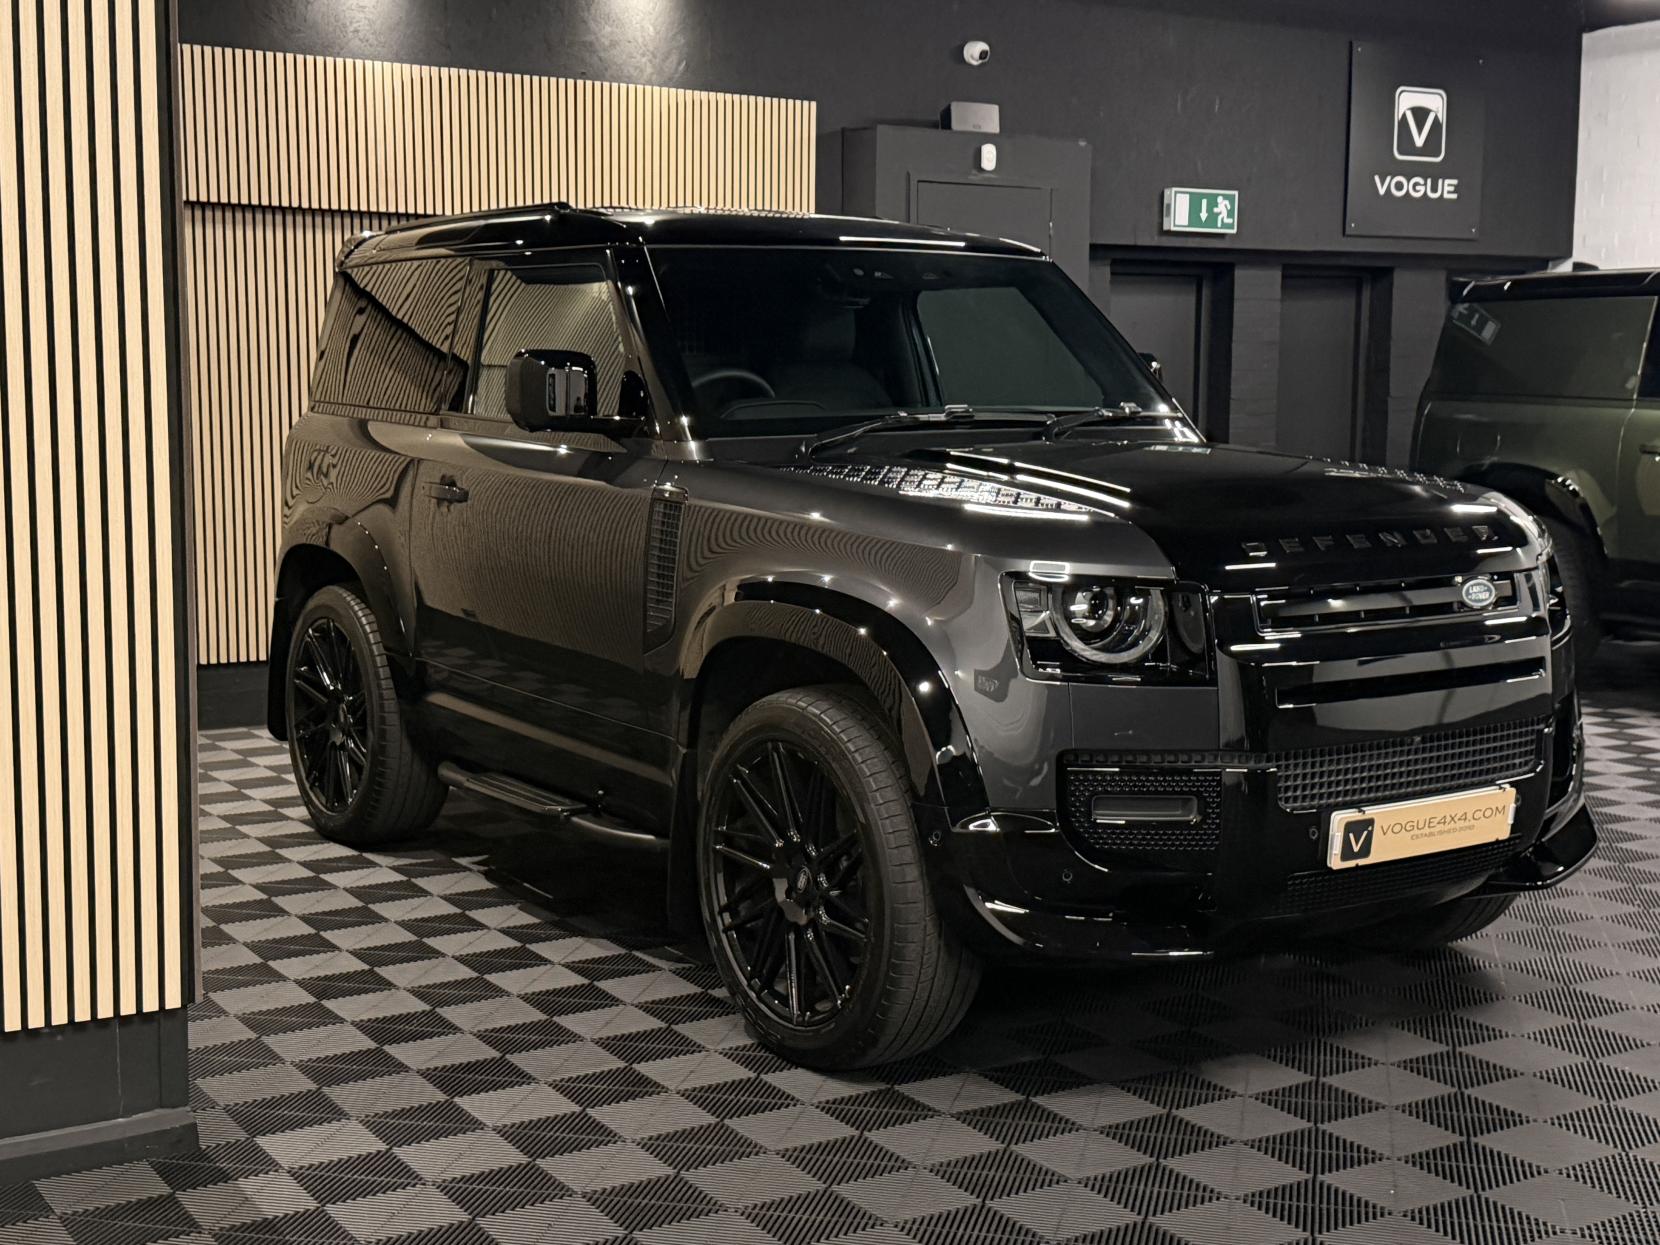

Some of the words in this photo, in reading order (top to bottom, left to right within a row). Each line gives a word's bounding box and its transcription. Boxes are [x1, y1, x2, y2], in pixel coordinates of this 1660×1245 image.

[1405, 108, 1437, 147] V
[1374, 174, 1458, 199] VOGUE
[1241, 525, 1498, 557] DEFENDER
[1380, 805, 1506, 836] VOGUE4X4.COM
